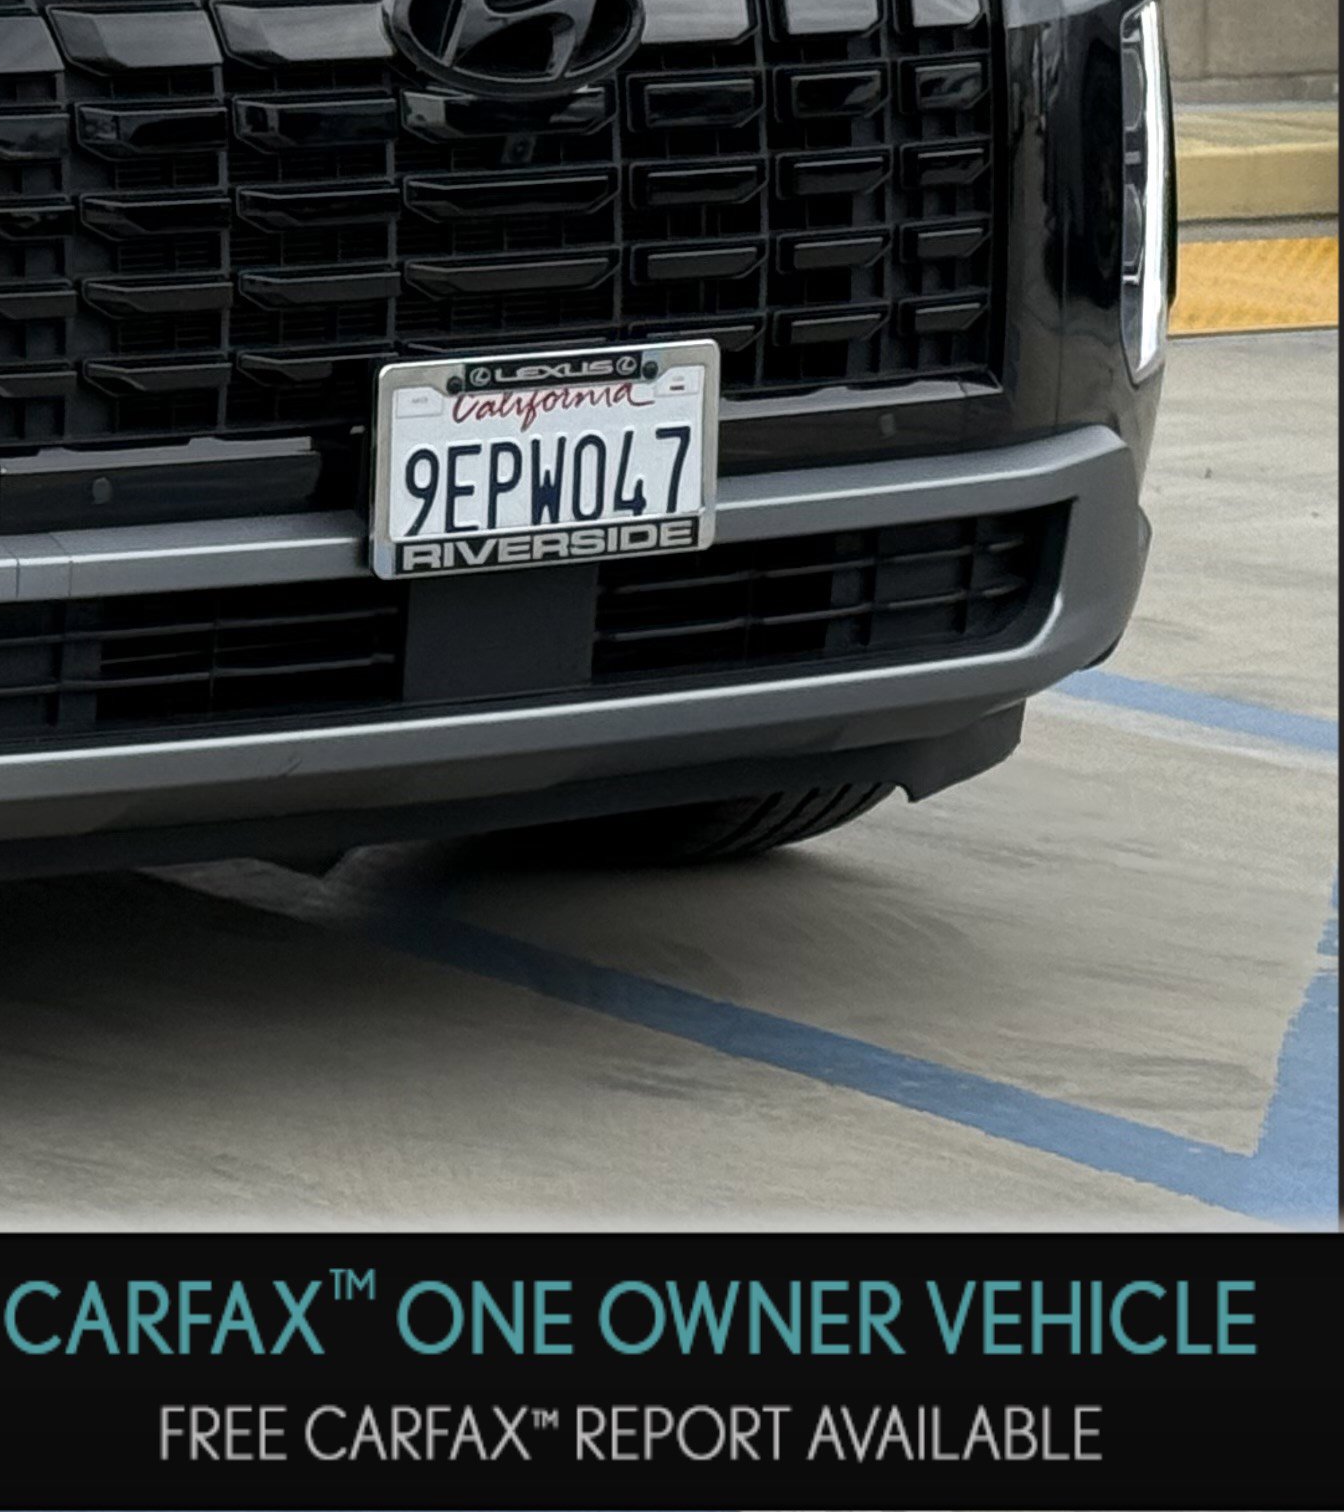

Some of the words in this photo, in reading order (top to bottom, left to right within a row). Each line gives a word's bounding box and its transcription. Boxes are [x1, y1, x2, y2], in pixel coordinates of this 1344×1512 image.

[495, 359, 614, 383] LEXUS
[451, 382, 655, 432] California
[404, 425, 692, 537] 9EPW047
[403, 519, 695, 571] RIVERSIDE
